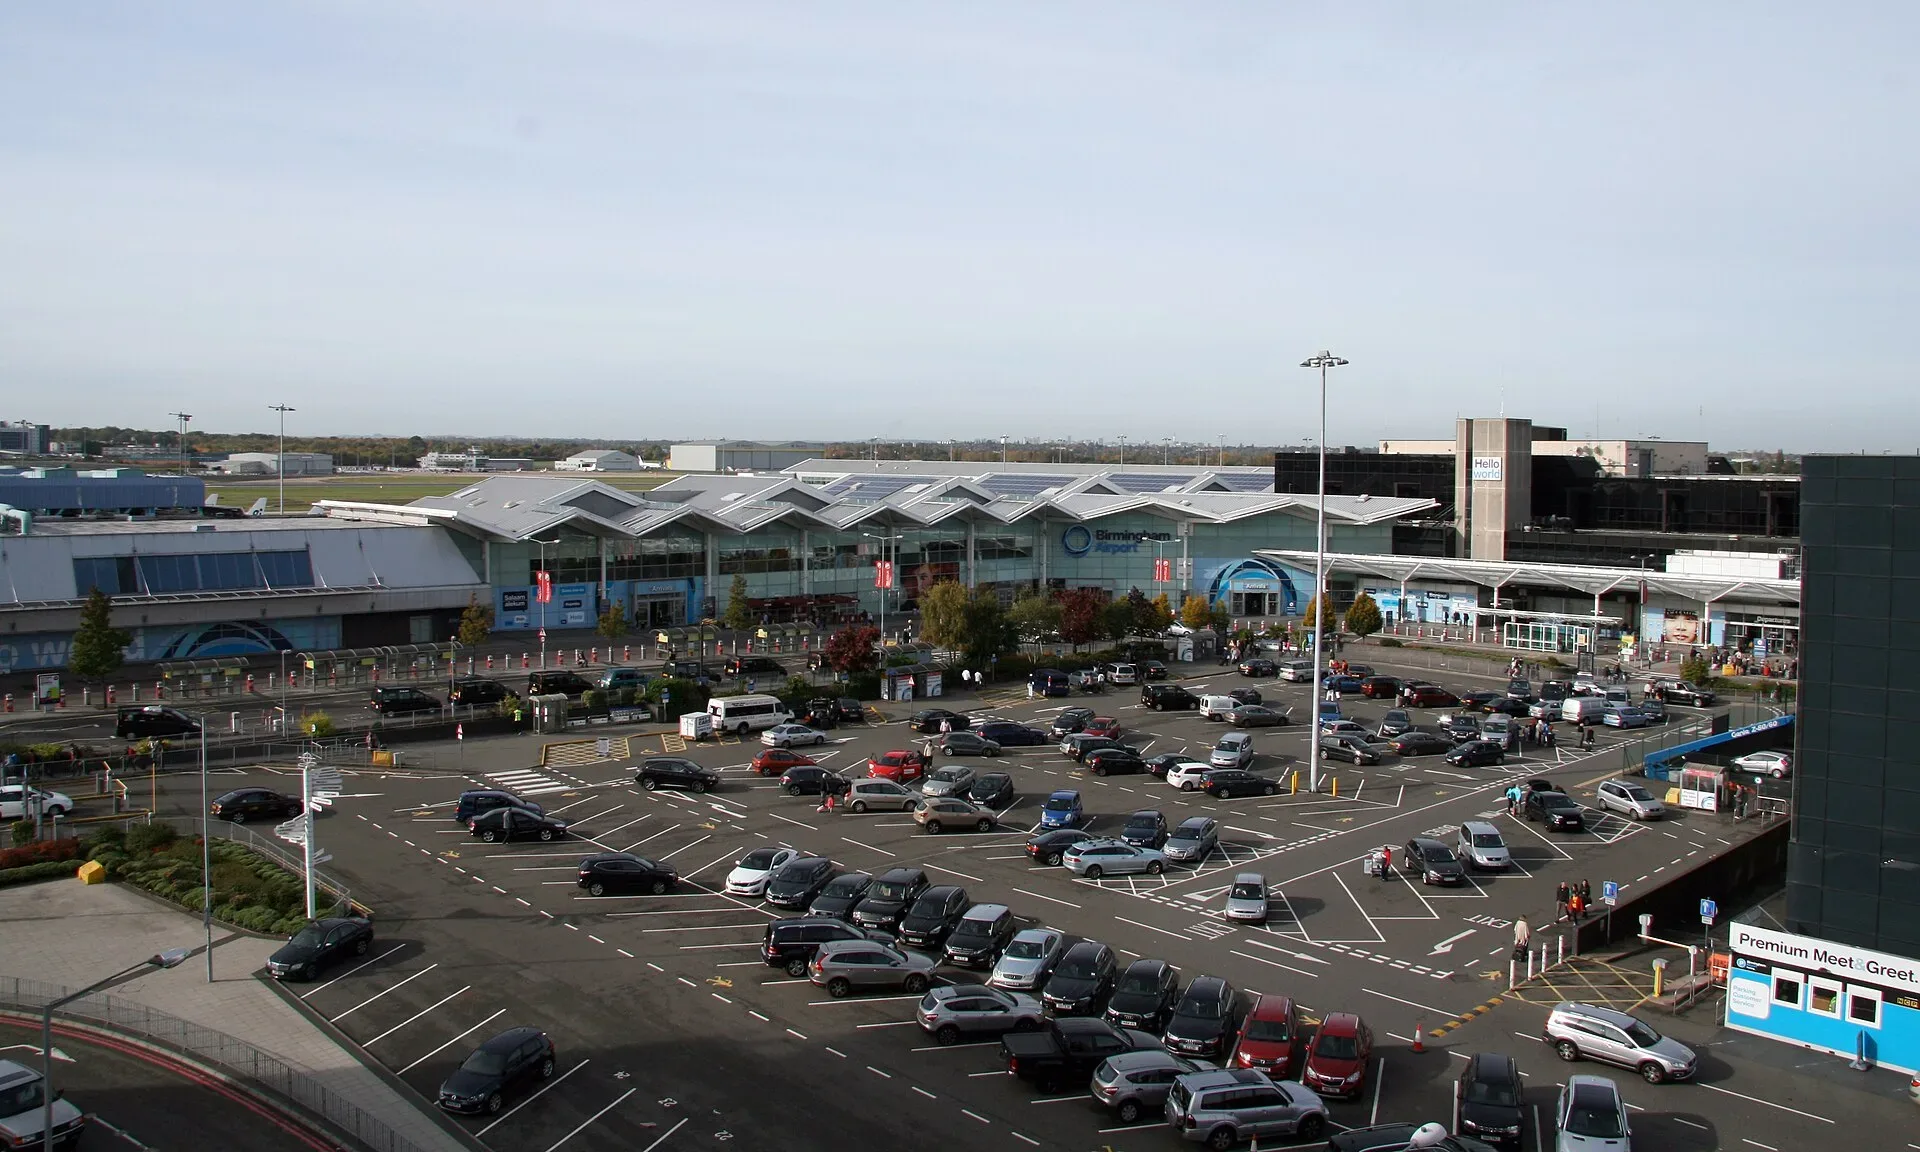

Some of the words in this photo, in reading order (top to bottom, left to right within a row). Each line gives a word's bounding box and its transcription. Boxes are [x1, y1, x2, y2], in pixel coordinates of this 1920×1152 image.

[1474, 459, 1500, 468] Hello
[1473, 469, 1500, 479] world
[1095, 529, 1171, 544] Birmingham
[1095, 542, 1138, 555] Airport
[1756, 615, 1791, 624] Departures
[1463, 914, 1513, 929] EXIT
[1739, 932, 1808, 958] Premium
